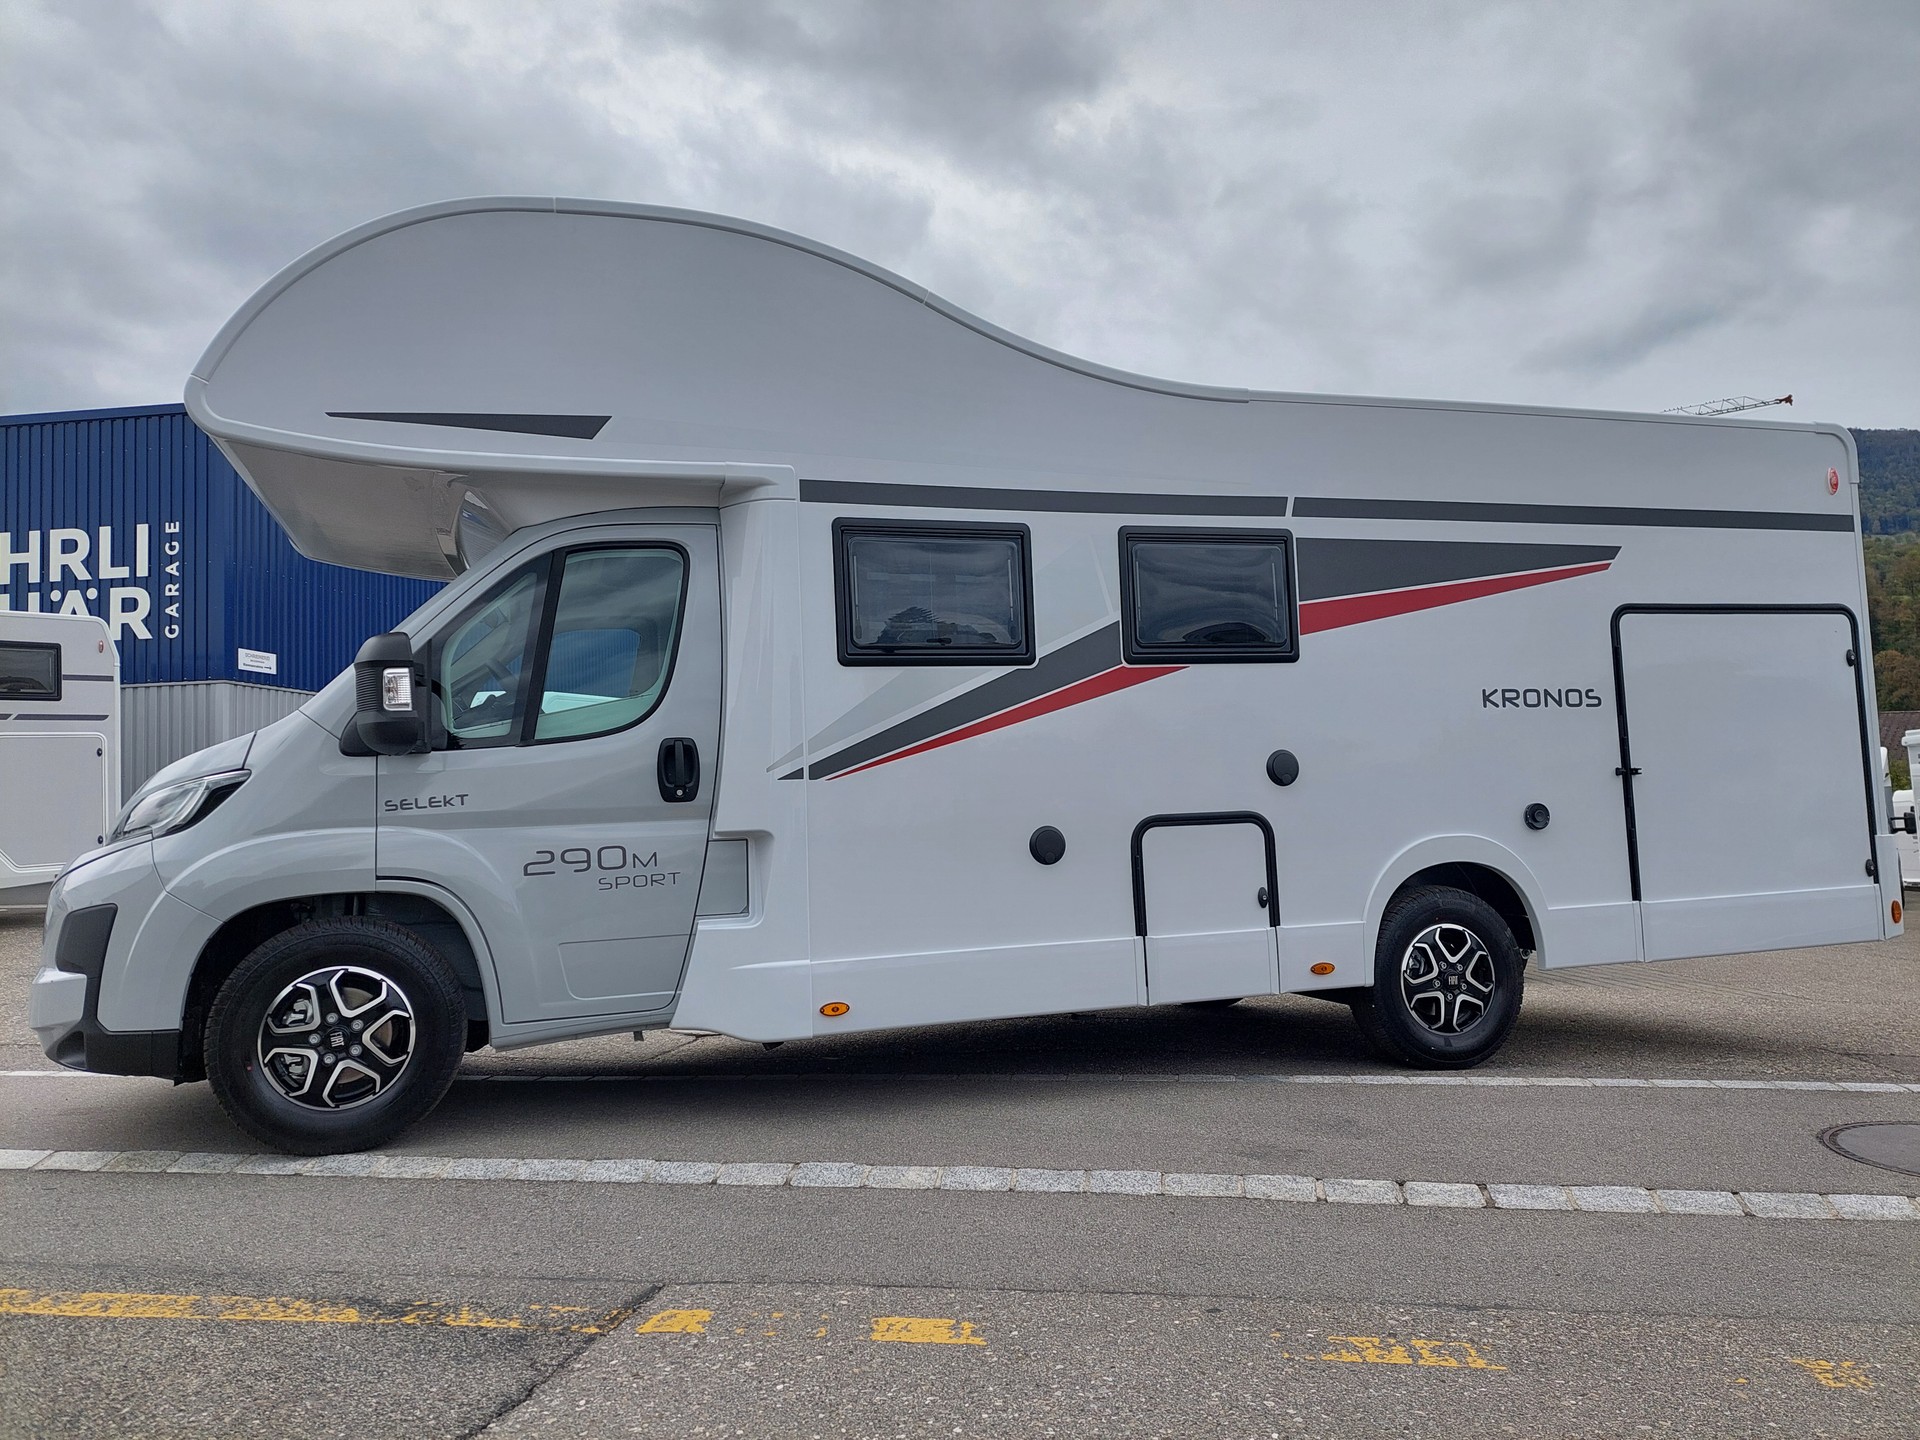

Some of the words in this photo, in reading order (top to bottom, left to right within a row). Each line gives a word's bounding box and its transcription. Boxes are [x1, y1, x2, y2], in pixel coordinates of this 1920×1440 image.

[0, 523, 149, 585] HRLI
[164, 521, 180, 639] GARAGE
[1482, 688, 1602, 708] KRONOS
[384, 793, 469, 812] SELEKT
[598, 872, 681, 890] SPORT
[330, 1031, 345, 1048] FIAT
